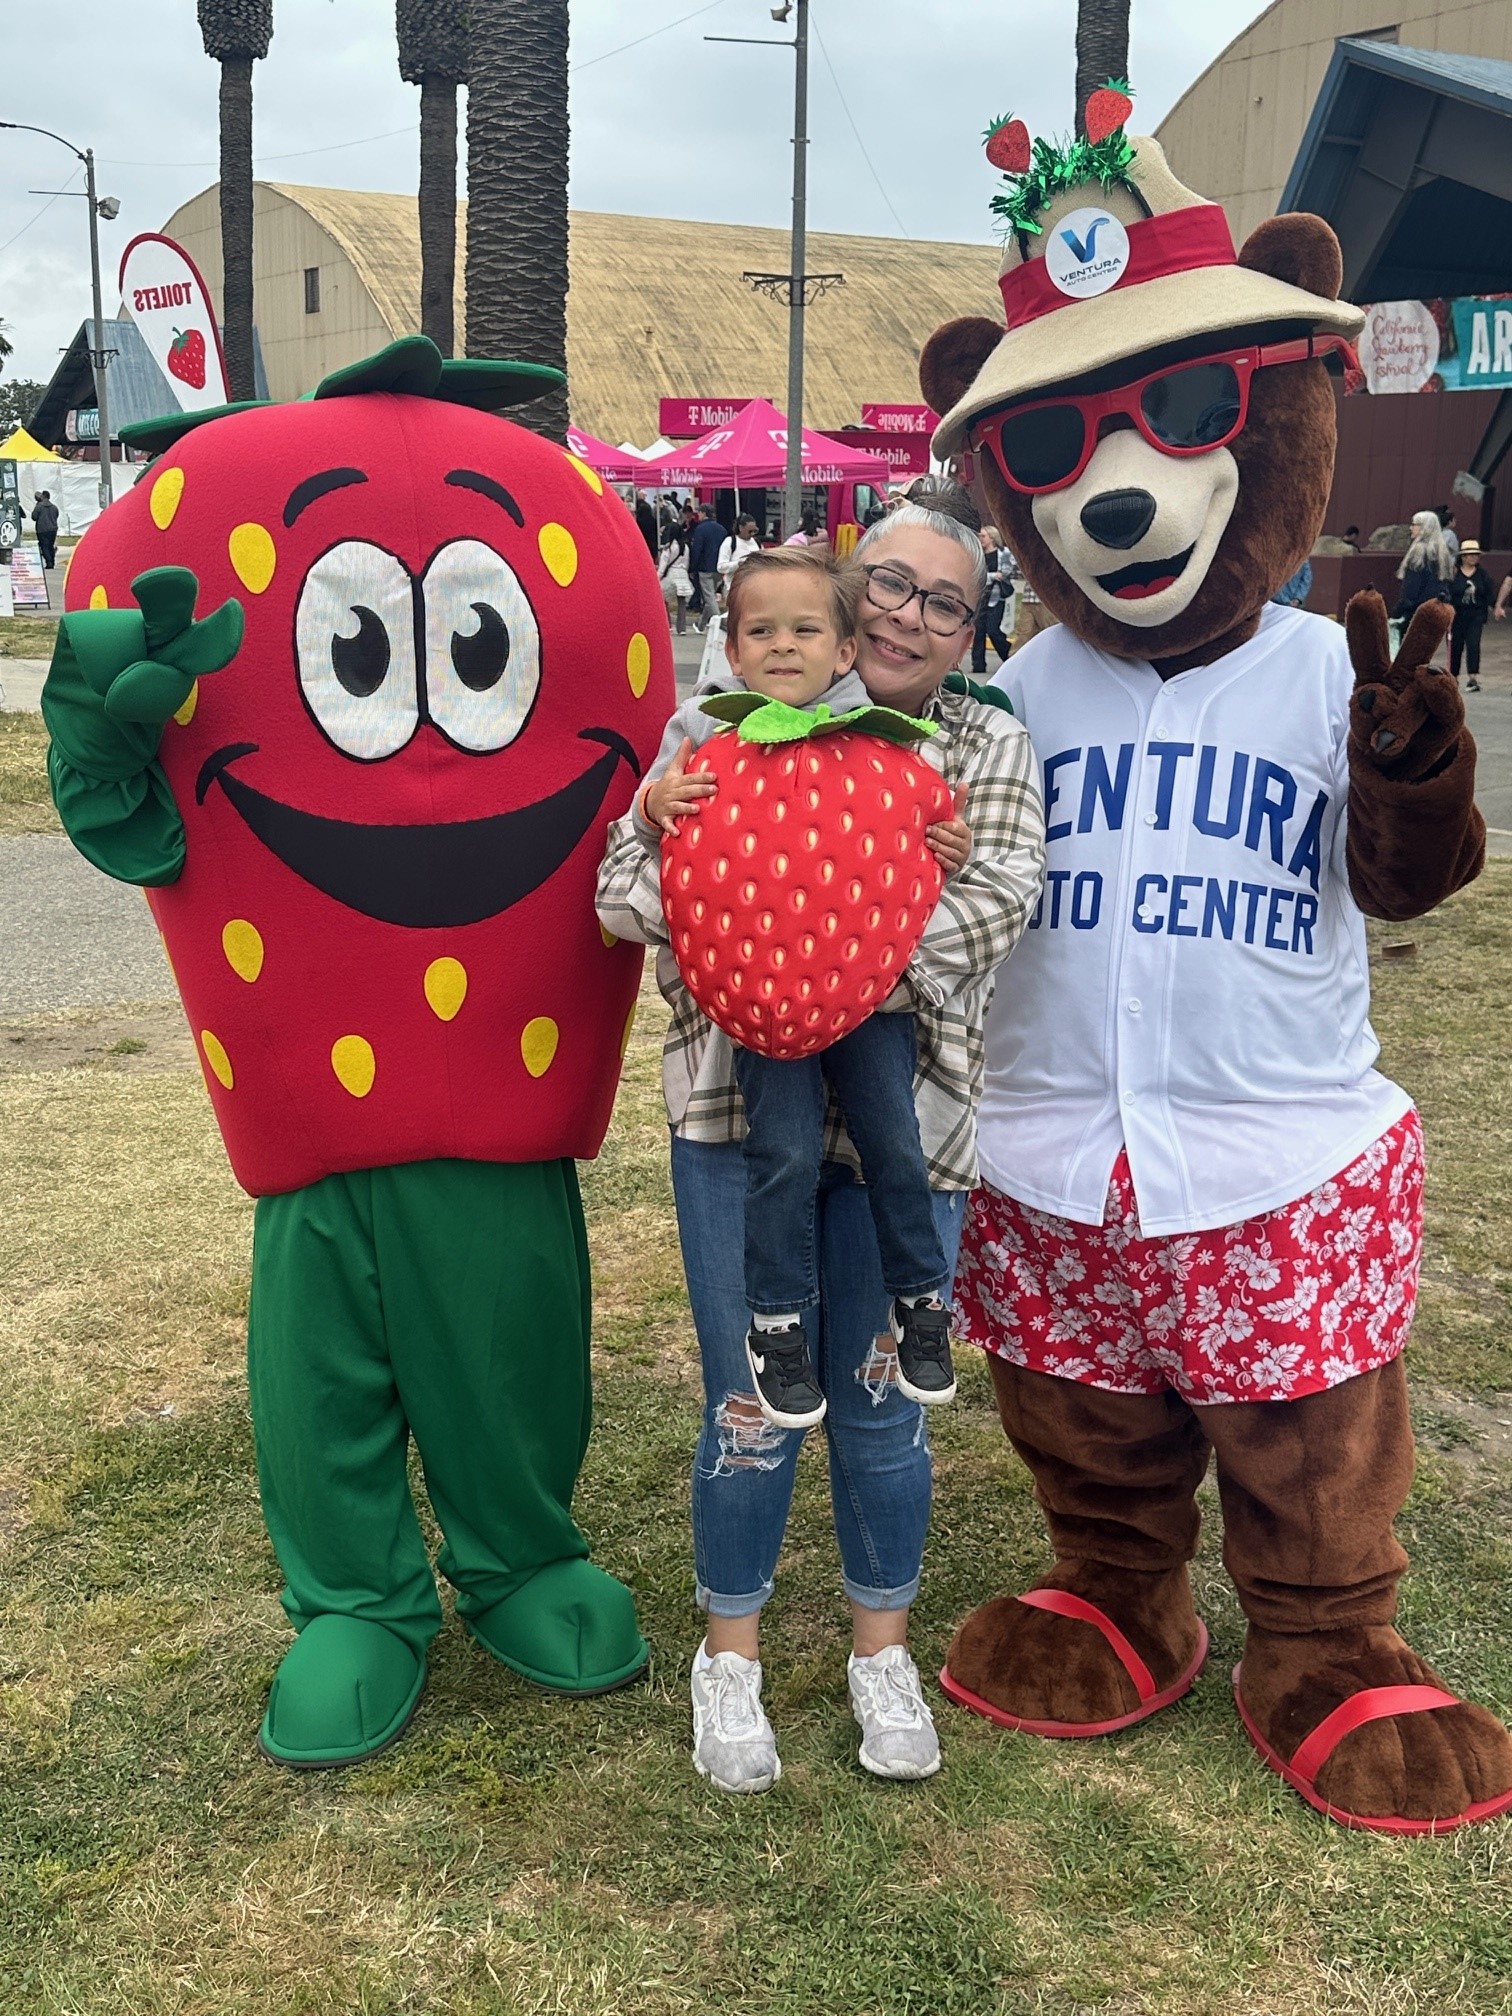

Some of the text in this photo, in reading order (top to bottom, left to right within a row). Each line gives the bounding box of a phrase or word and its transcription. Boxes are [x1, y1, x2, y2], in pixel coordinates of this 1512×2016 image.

[1060, 258, 1121, 282] VENTURA
[1067, 267, 1117, 287] AUTO CENTER
[1044, 741, 1329, 895] ENTURA
[1132, 873, 1319, 956] CENTER
